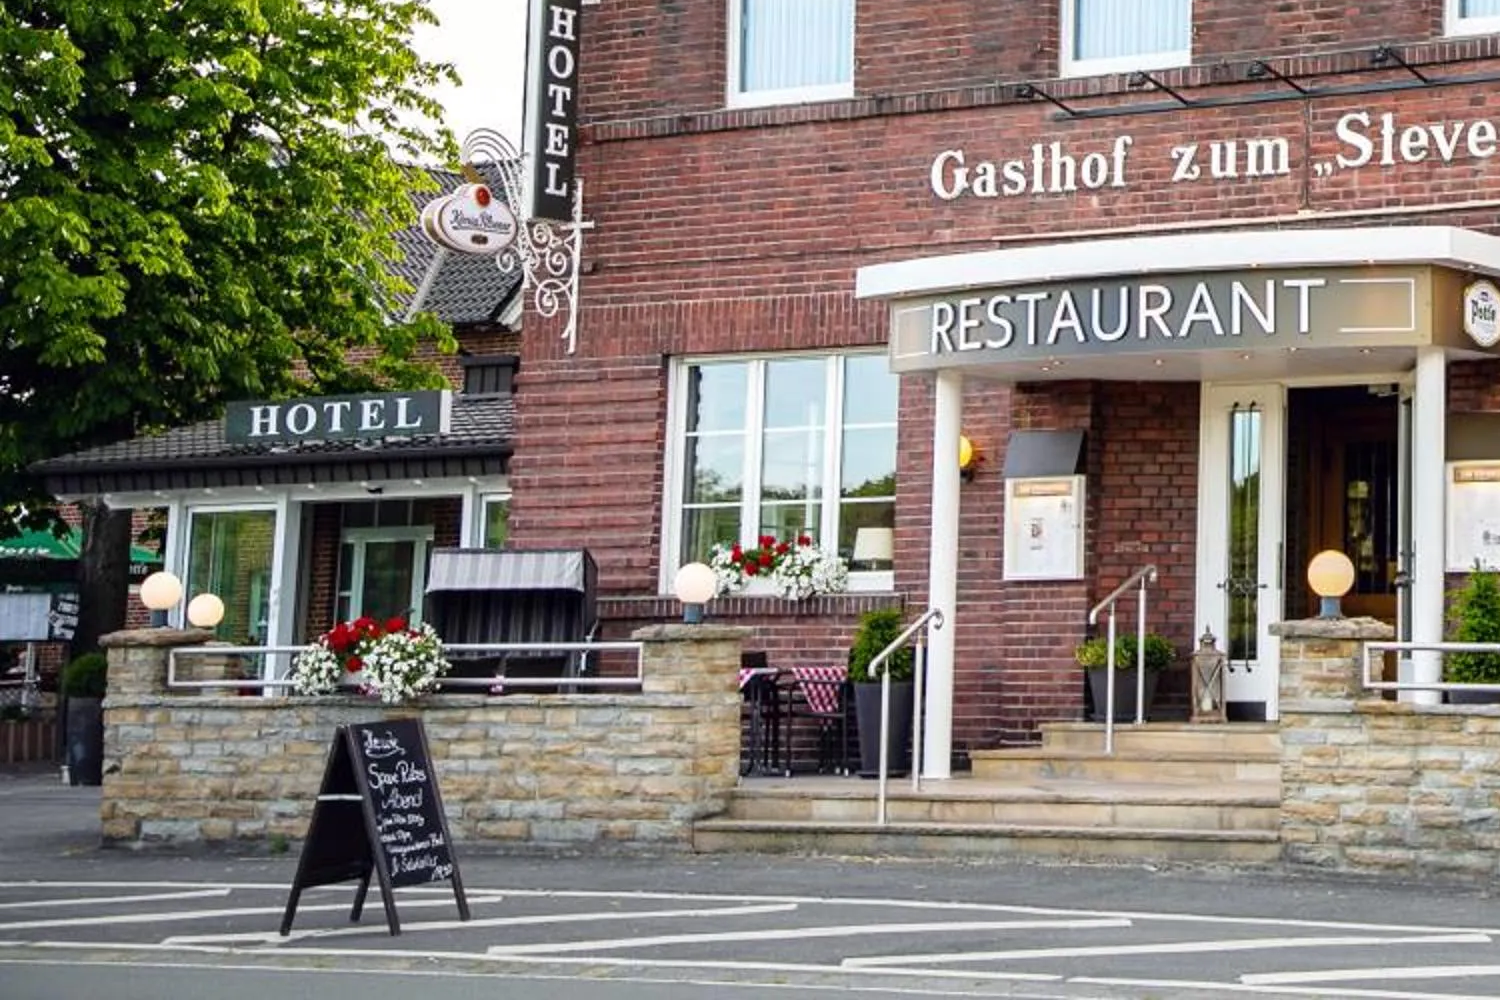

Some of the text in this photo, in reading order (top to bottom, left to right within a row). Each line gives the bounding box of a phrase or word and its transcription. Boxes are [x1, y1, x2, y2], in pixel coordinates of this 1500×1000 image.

[544, 4, 577, 198] HOTEL
[930, 135, 1134, 200] Gasthof
[1170, 136, 1291, 183] zum
[929, 278, 1327, 354] RESTAURANT
[248, 397, 423, 437] HOTEL
[381, 787, 423, 809] Abend
